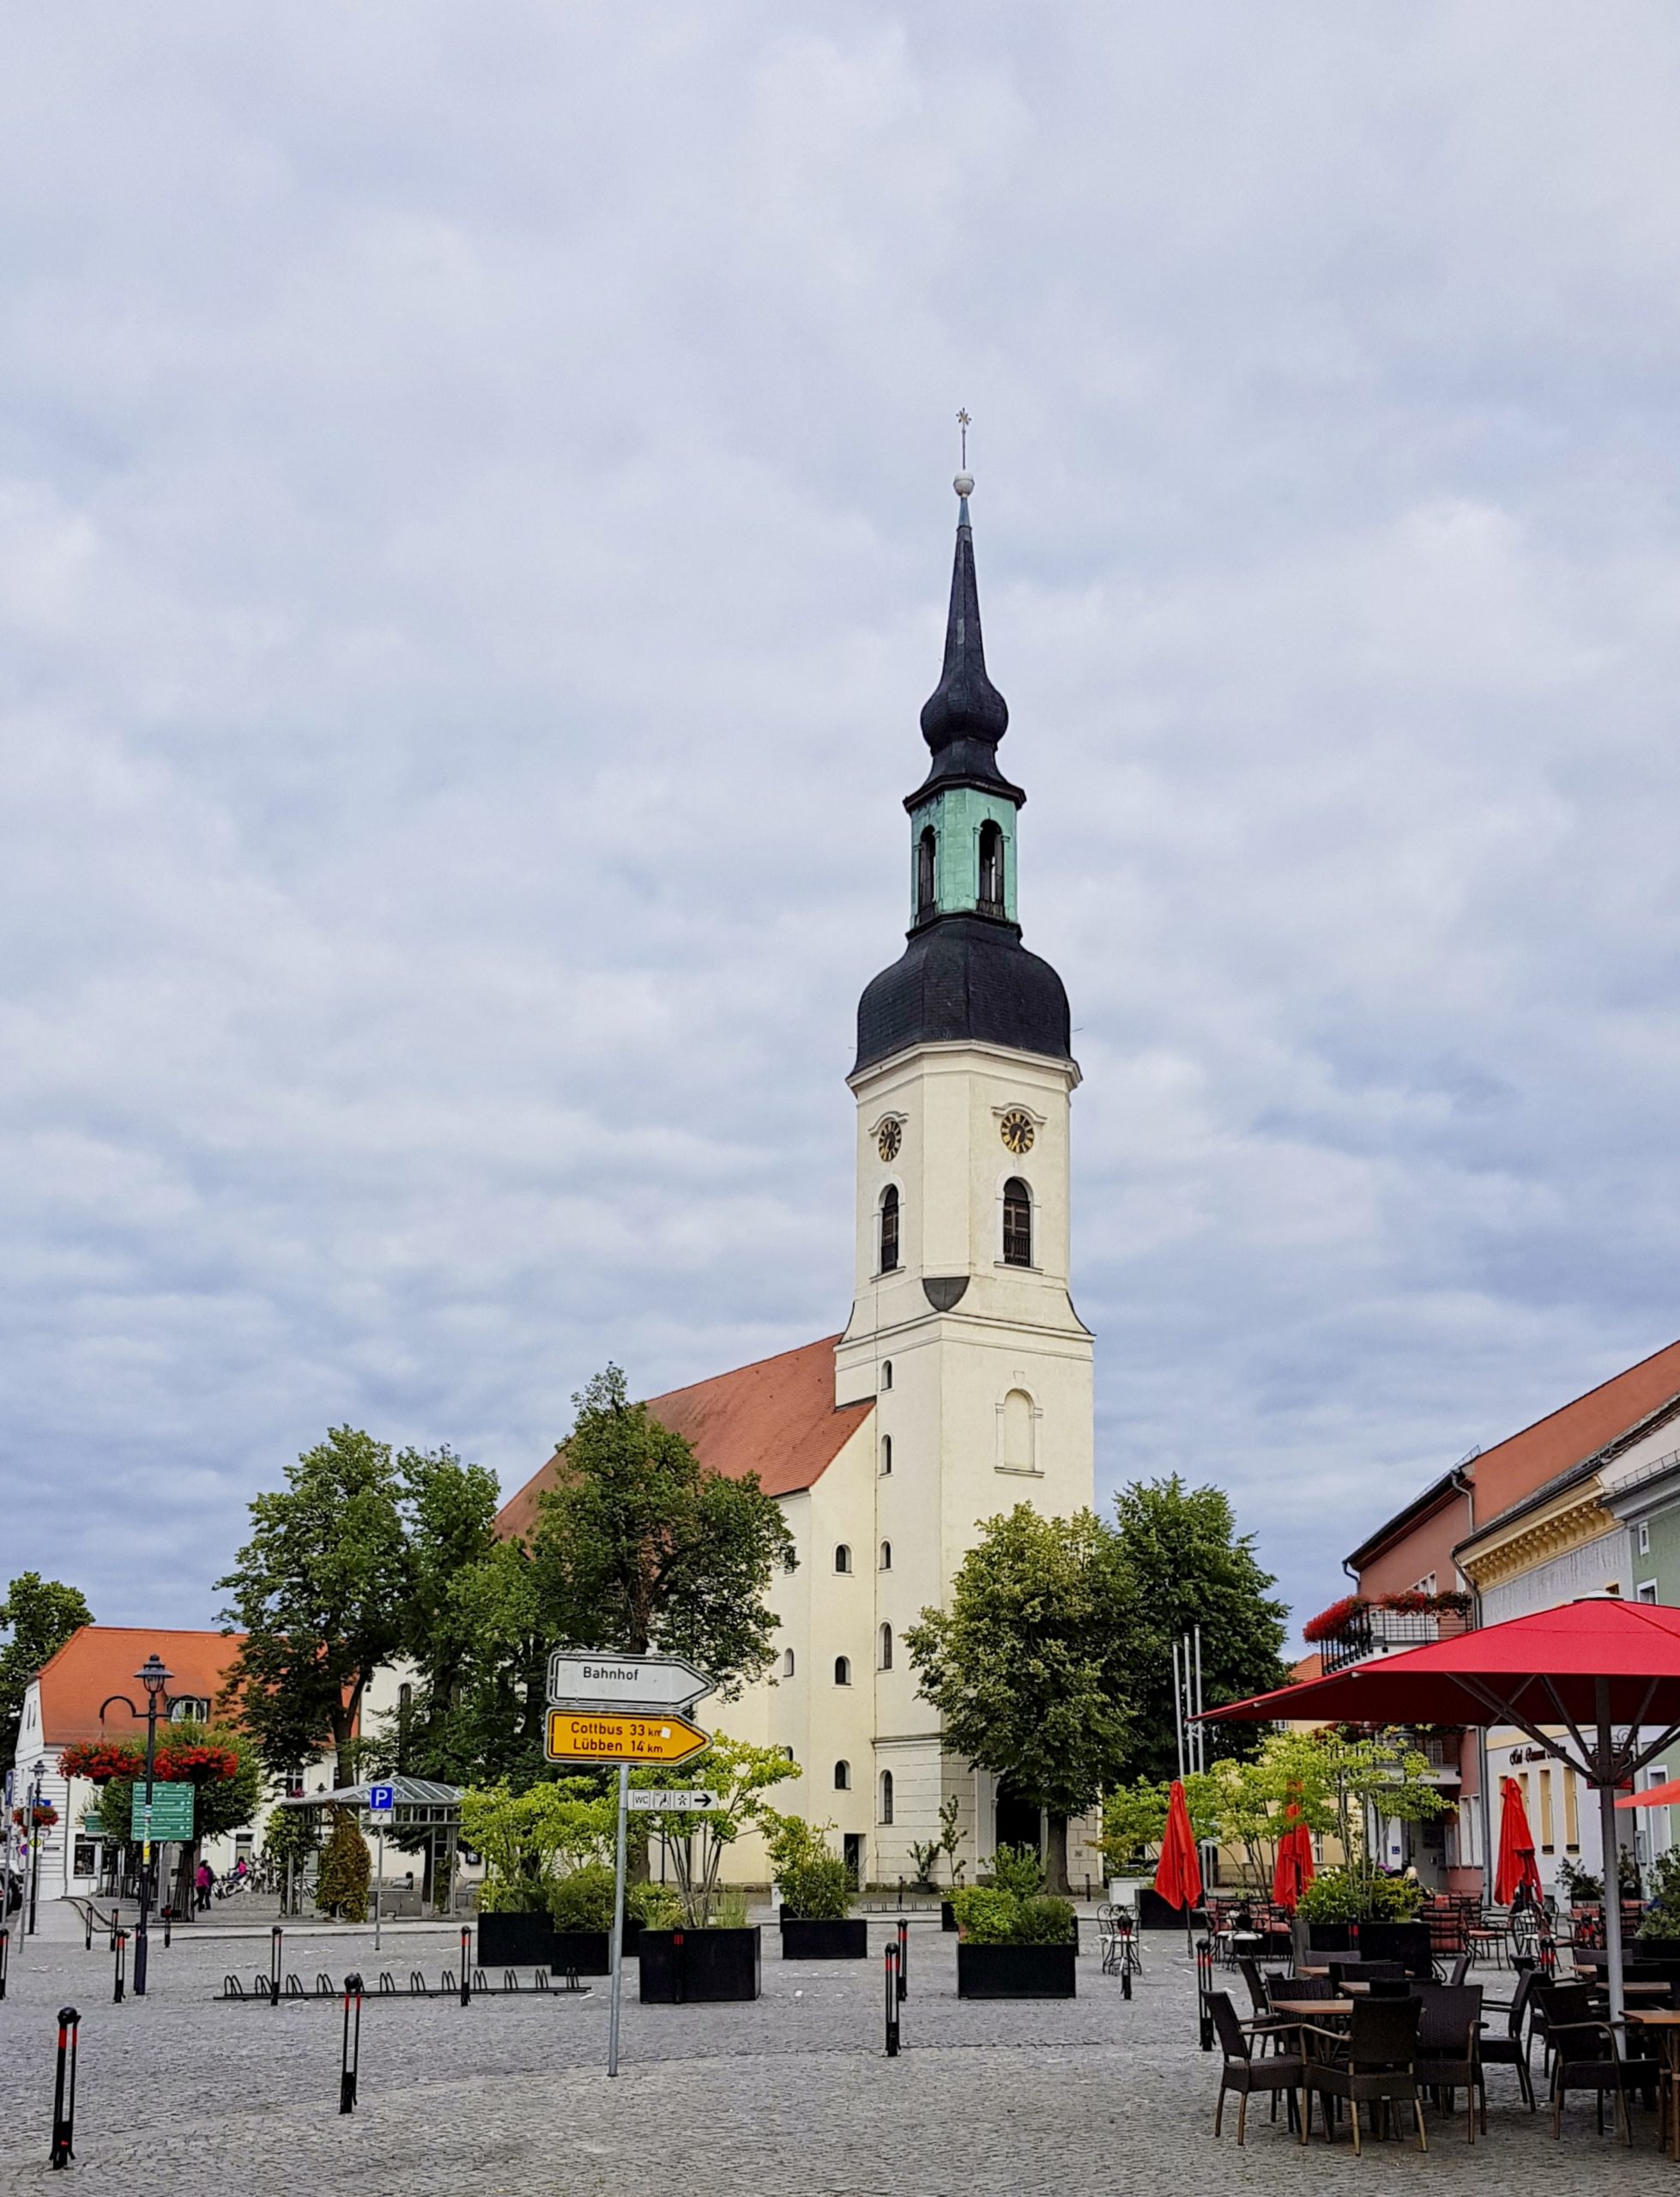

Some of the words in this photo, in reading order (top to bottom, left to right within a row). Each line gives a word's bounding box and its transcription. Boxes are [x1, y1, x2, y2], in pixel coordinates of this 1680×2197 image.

[583, 1666, 638, 1680] Bahnhof
[571, 1722, 623, 1735] Cottbus
[630, 1724, 645, 1736] 33
[573, 1738, 623, 1752] Lübben
[631, 1740, 644, 1752] 14
[647, 1744, 663, 1753] km
[376, 1789, 388, 1807] P
